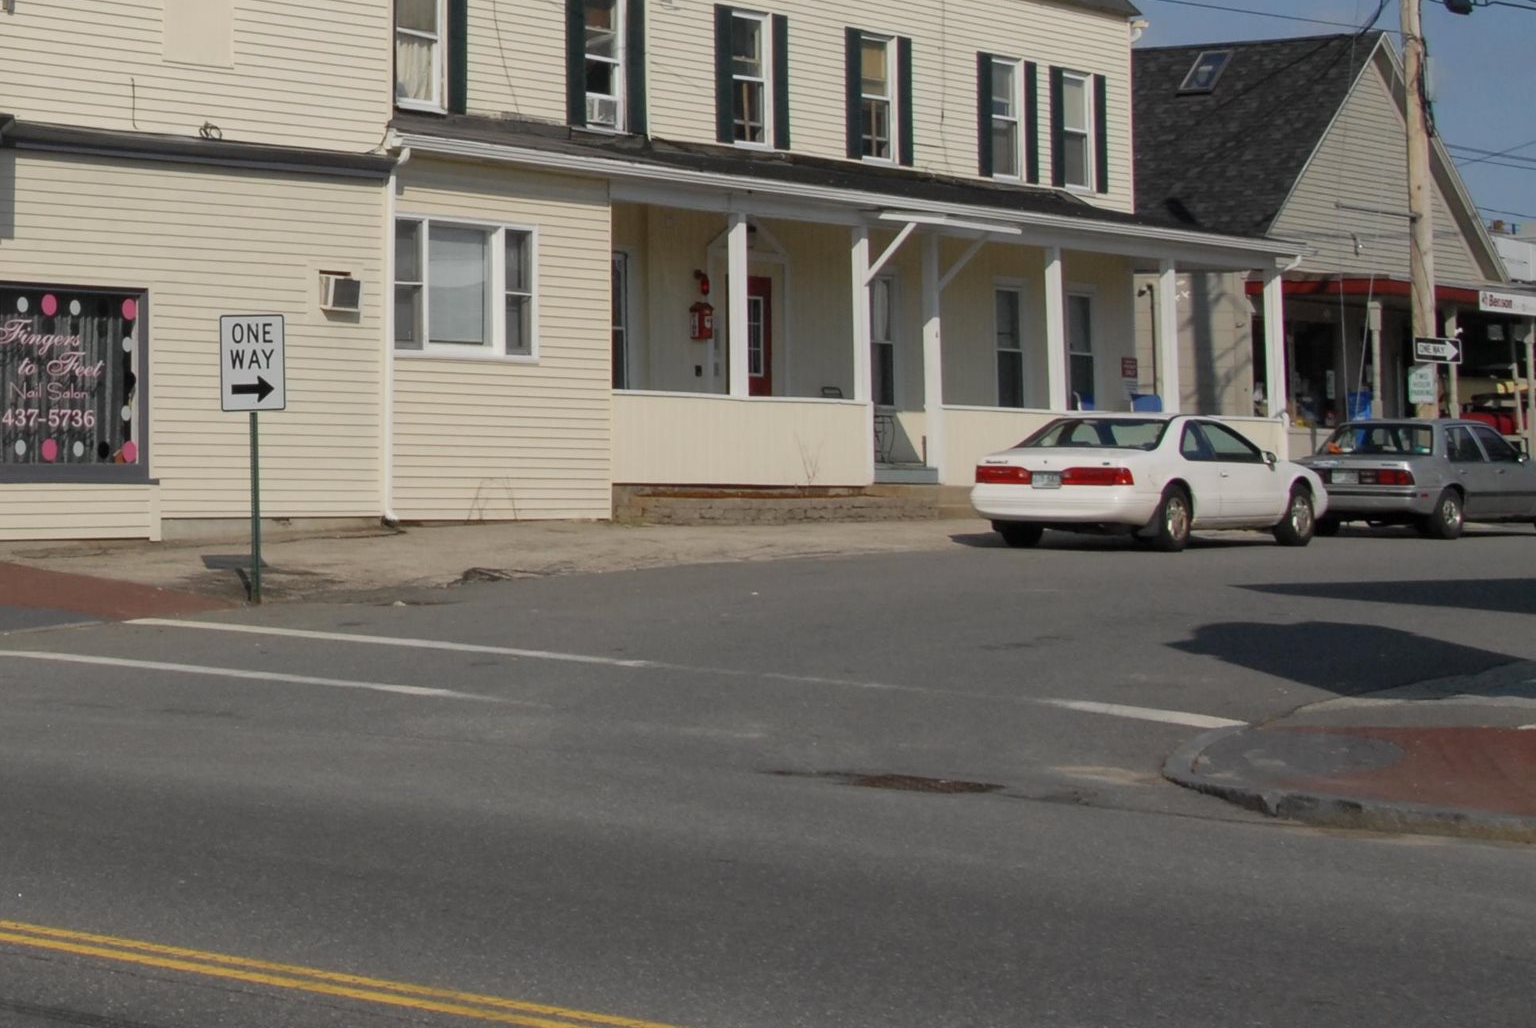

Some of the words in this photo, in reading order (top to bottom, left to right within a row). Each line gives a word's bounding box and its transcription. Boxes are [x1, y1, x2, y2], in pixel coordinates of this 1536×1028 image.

[232, 323, 273, 344] ONE
[230, 348, 275, 370] WAY
[1419, 344, 1431, 353] ONE
[1432, 345, 1445, 354] WAY
[17, 357, 37, 376] to
[47, 351, 104, 378] Feet
[9, 382, 42, 400] Nail
[47, 382, 89, 401] Salon
[1, 408, 96, 428] 437-5736
